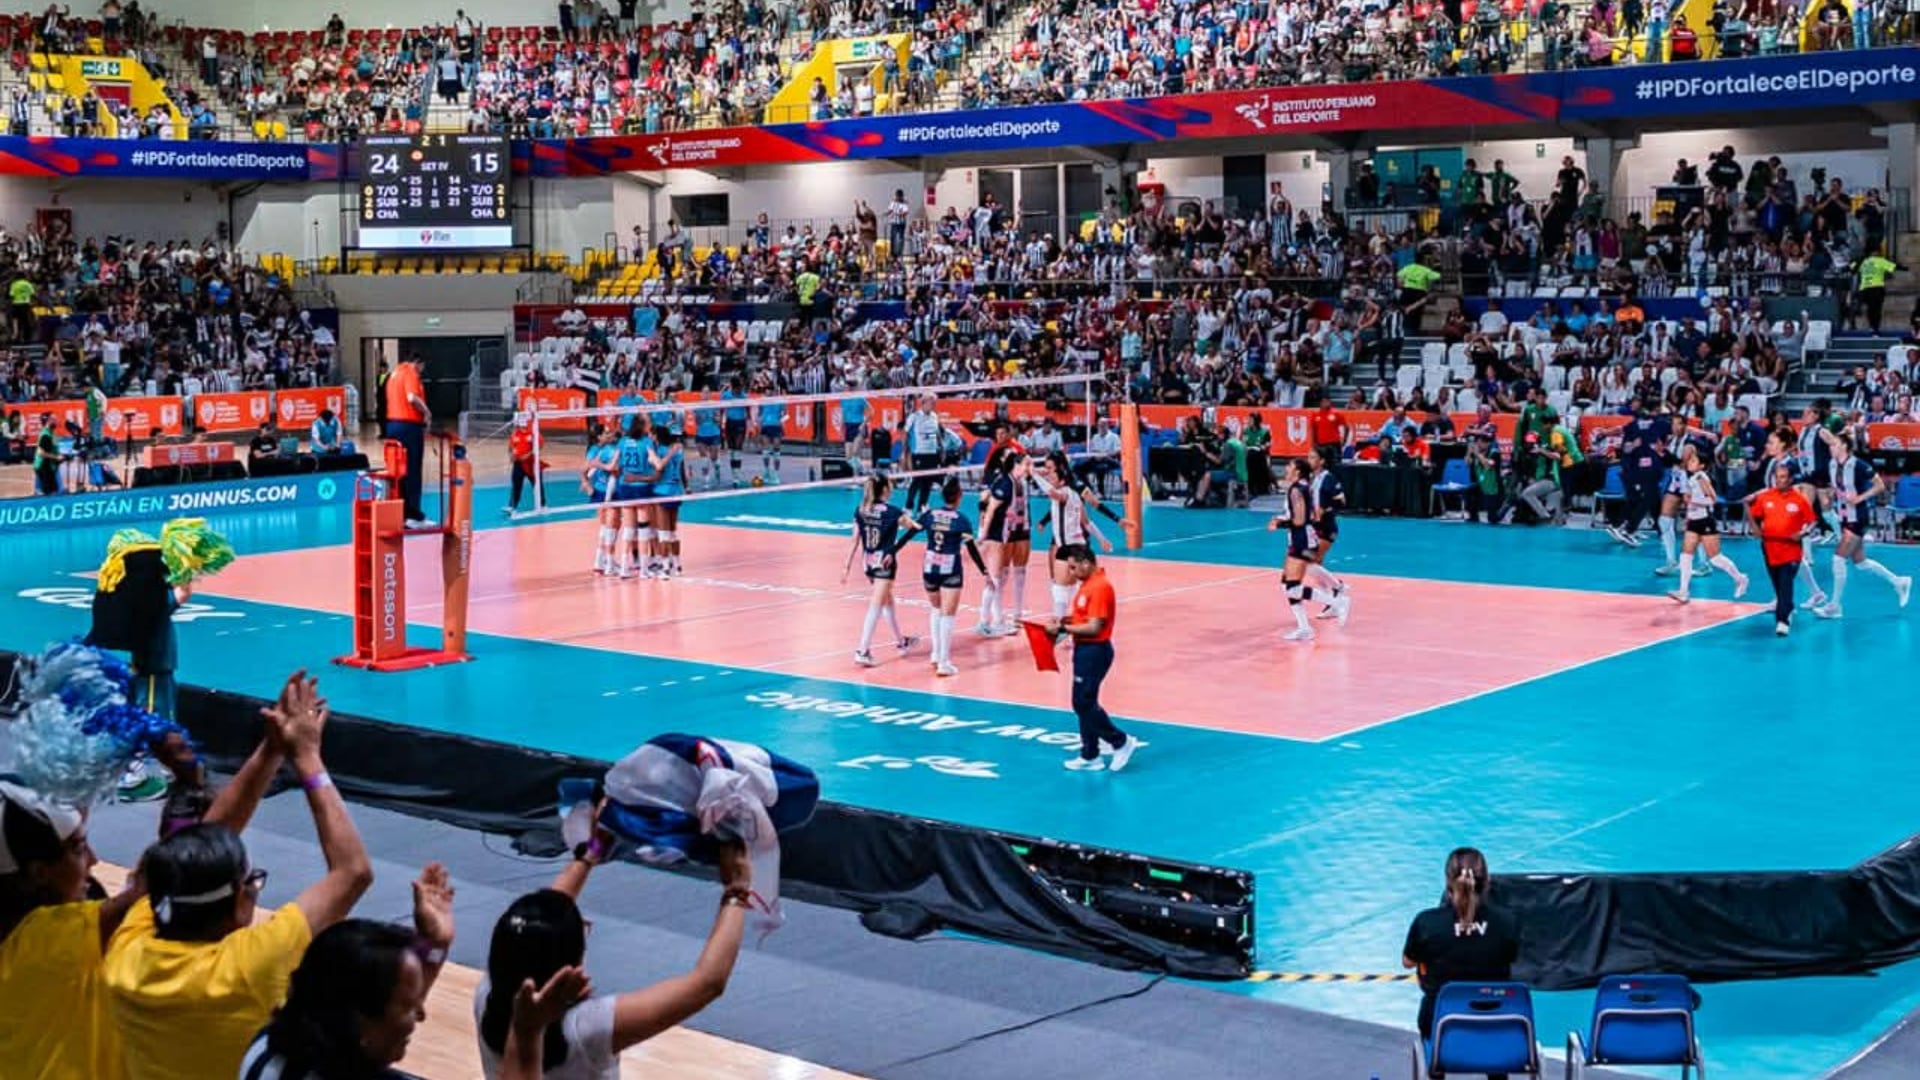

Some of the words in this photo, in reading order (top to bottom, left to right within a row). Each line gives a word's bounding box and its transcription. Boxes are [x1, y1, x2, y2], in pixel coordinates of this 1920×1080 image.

[1636, 64, 1916, 99] #IPDFortaleceElDeporte
[1272, 98, 1324, 111] INSTITUTO
[1326, 95, 1376, 106] PERUANO
[1273, 113, 1291, 124] DEL
[1293, 110, 1340, 122] DEPORTE
[898, 119, 1060, 141] #IPDFortaleceElDeporte
[421, 135, 430, 146] 2
[438, 135, 446, 146] 1
[131, 151, 305, 171] #IPDFortaleceElDeporte
[370, 154, 400, 173] 24
[471, 153, 499, 173] 15
[409, 176, 422, 185] 25
[448, 175, 461, 184] 14
[364, 186, 374, 196] 0
[376, 185, 399, 197] T/O
[471, 184, 494, 196] T/O
[496, 184, 505, 195] 2
[364, 197, 374, 208] 2
[376, 197, 399, 207] SUB
[471, 196, 494, 206] SUB
[498, 196, 504, 206] 1
[364, 209, 374, 219] 0
[376, 209, 399, 219] CHA
[471, 208, 494, 218] CHA
[496, 208, 505, 218] 0
[625, 452, 639, 468] 23
[0, 503, 66, 525] IUDAD
[71, 498, 132, 519] ESTÁN
[138, 497, 164, 513] EN
[168, 484, 297, 511] JOINNUS.COM
[384, 553, 396, 640] betsson
[745, 690, 990, 732] Athletic
